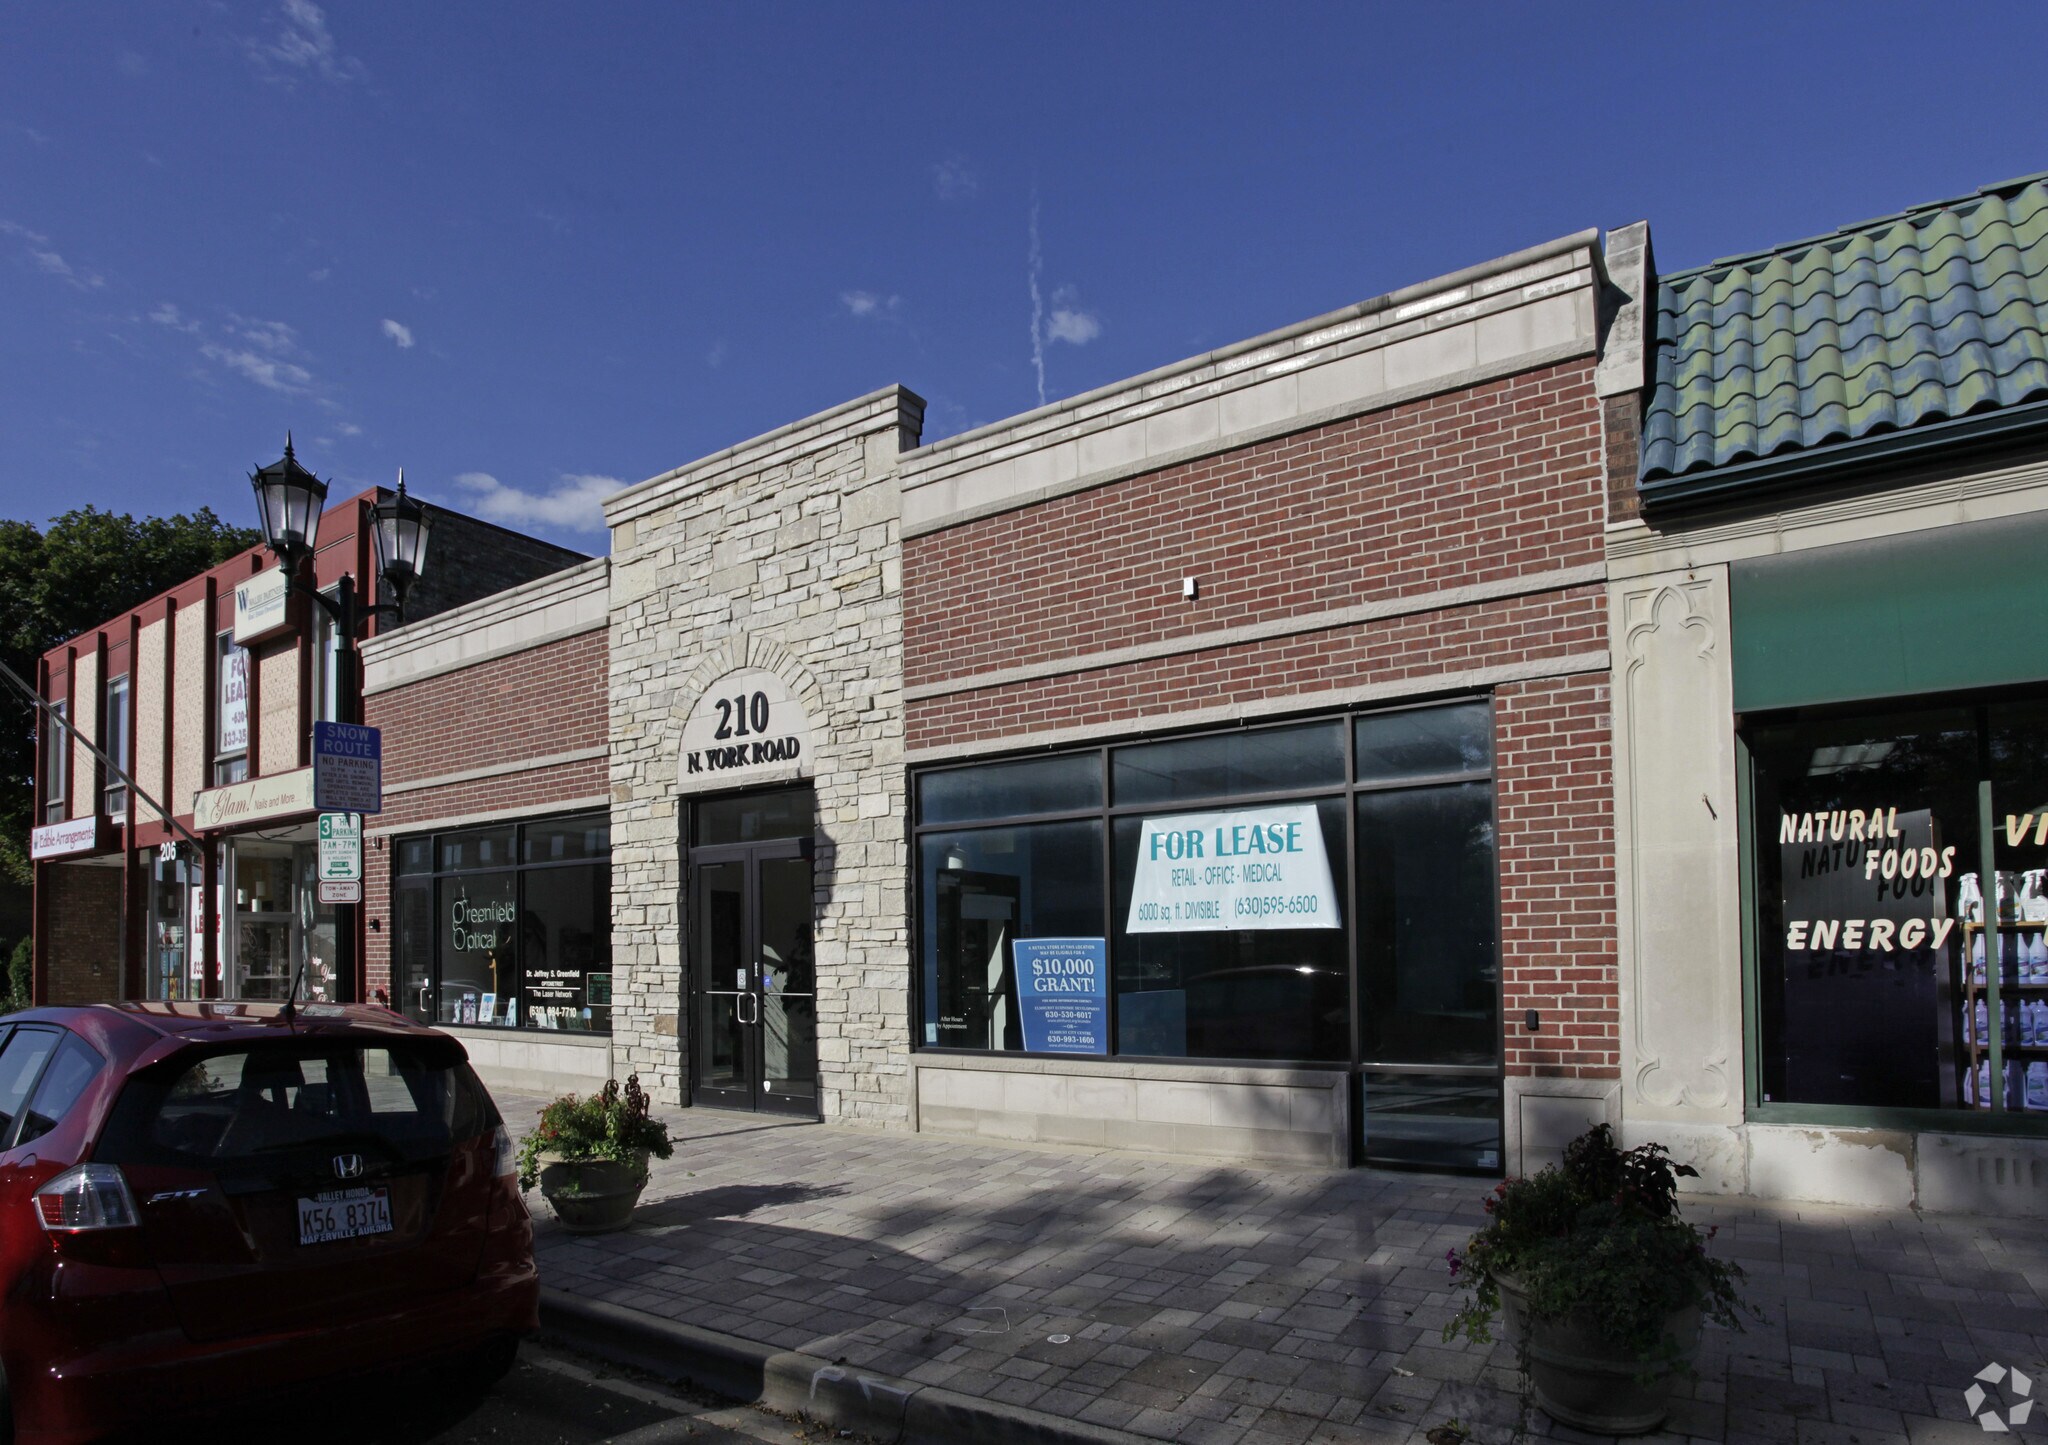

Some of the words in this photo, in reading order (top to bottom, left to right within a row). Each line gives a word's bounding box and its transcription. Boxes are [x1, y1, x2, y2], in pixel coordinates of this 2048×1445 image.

[714, 691, 769, 740] 210
[327, 725, 369, 741] SNOW
[323, 739, 372, 756] ROUTE
[687, 751, 703, 774] N.
[705, 743, 750, 772] YORK
[752, 736, 800, 764] ROAD
[322, 756, 334, 766] NO
[338, 758, 374, 769] PARKING
[211, 784, 256, 824] Glam!
[254, 800, 268, 811] Nails
[269, 796, 280, 808] and
[321, 819, 330, 836] 3
[332, 828, 357, 837] PARKING
[1779, 807, 1900, 844] NATURAL
[40, 828, 55, 849] Edible
[56, 827, 95, 849] Arrangements
[1150, 829, 1204, 861] FOR
[1216, 822, 1303, 857] LEASE
[160, 841, 177, 862] 206
[1865, 846, 1956, 880] FOODS
[1172, 868, 1197, 887] RETAIL
[1205, 865, 1235, 885] OFFICE
[1243, 863, 1282, 883] MEDICAL
[452, 899, 516, 924] Greenfield
[1138, 903, 1158, 921] 6000
[1160, 906, 1172, 924] sq.
[1185, 901, 1220, 920] DIVISIBLE
[1234, 895, 1317, 920] (630)595-6500
[195, 913, 221, 934] LEE
[453, 928, 497, 952] Optical
[1786, 918, 1955, 952] ENERGY
[534, 970, 549, 979] Jeffrey
[550, 970, 555, 978] S.
[557, 970, 580, 978] Greenfield
[1032, 958, 1094, 977] $10,000
[533, 990, 541, 998] The
[542, 990, 554, 998] Laser
[555, 990, 573, 998] Network
[1034, 978, 1095, 992] GRANT!
[1045, 1011, 1092, 1019] 630-530-6017
[1047, 1036, 1095, 1044] 630-993-1600
[151, 1188, 208, 1202] FIT
[318, 1190, 344, 1203] VALLEY
[346, 1187, 370, 1199] HONDA
[303, 1207, 335, 1236] K56
[347, 1200, 387, 1229] 8374
[300, 1230, 356, 1245] NAPERVILLE
